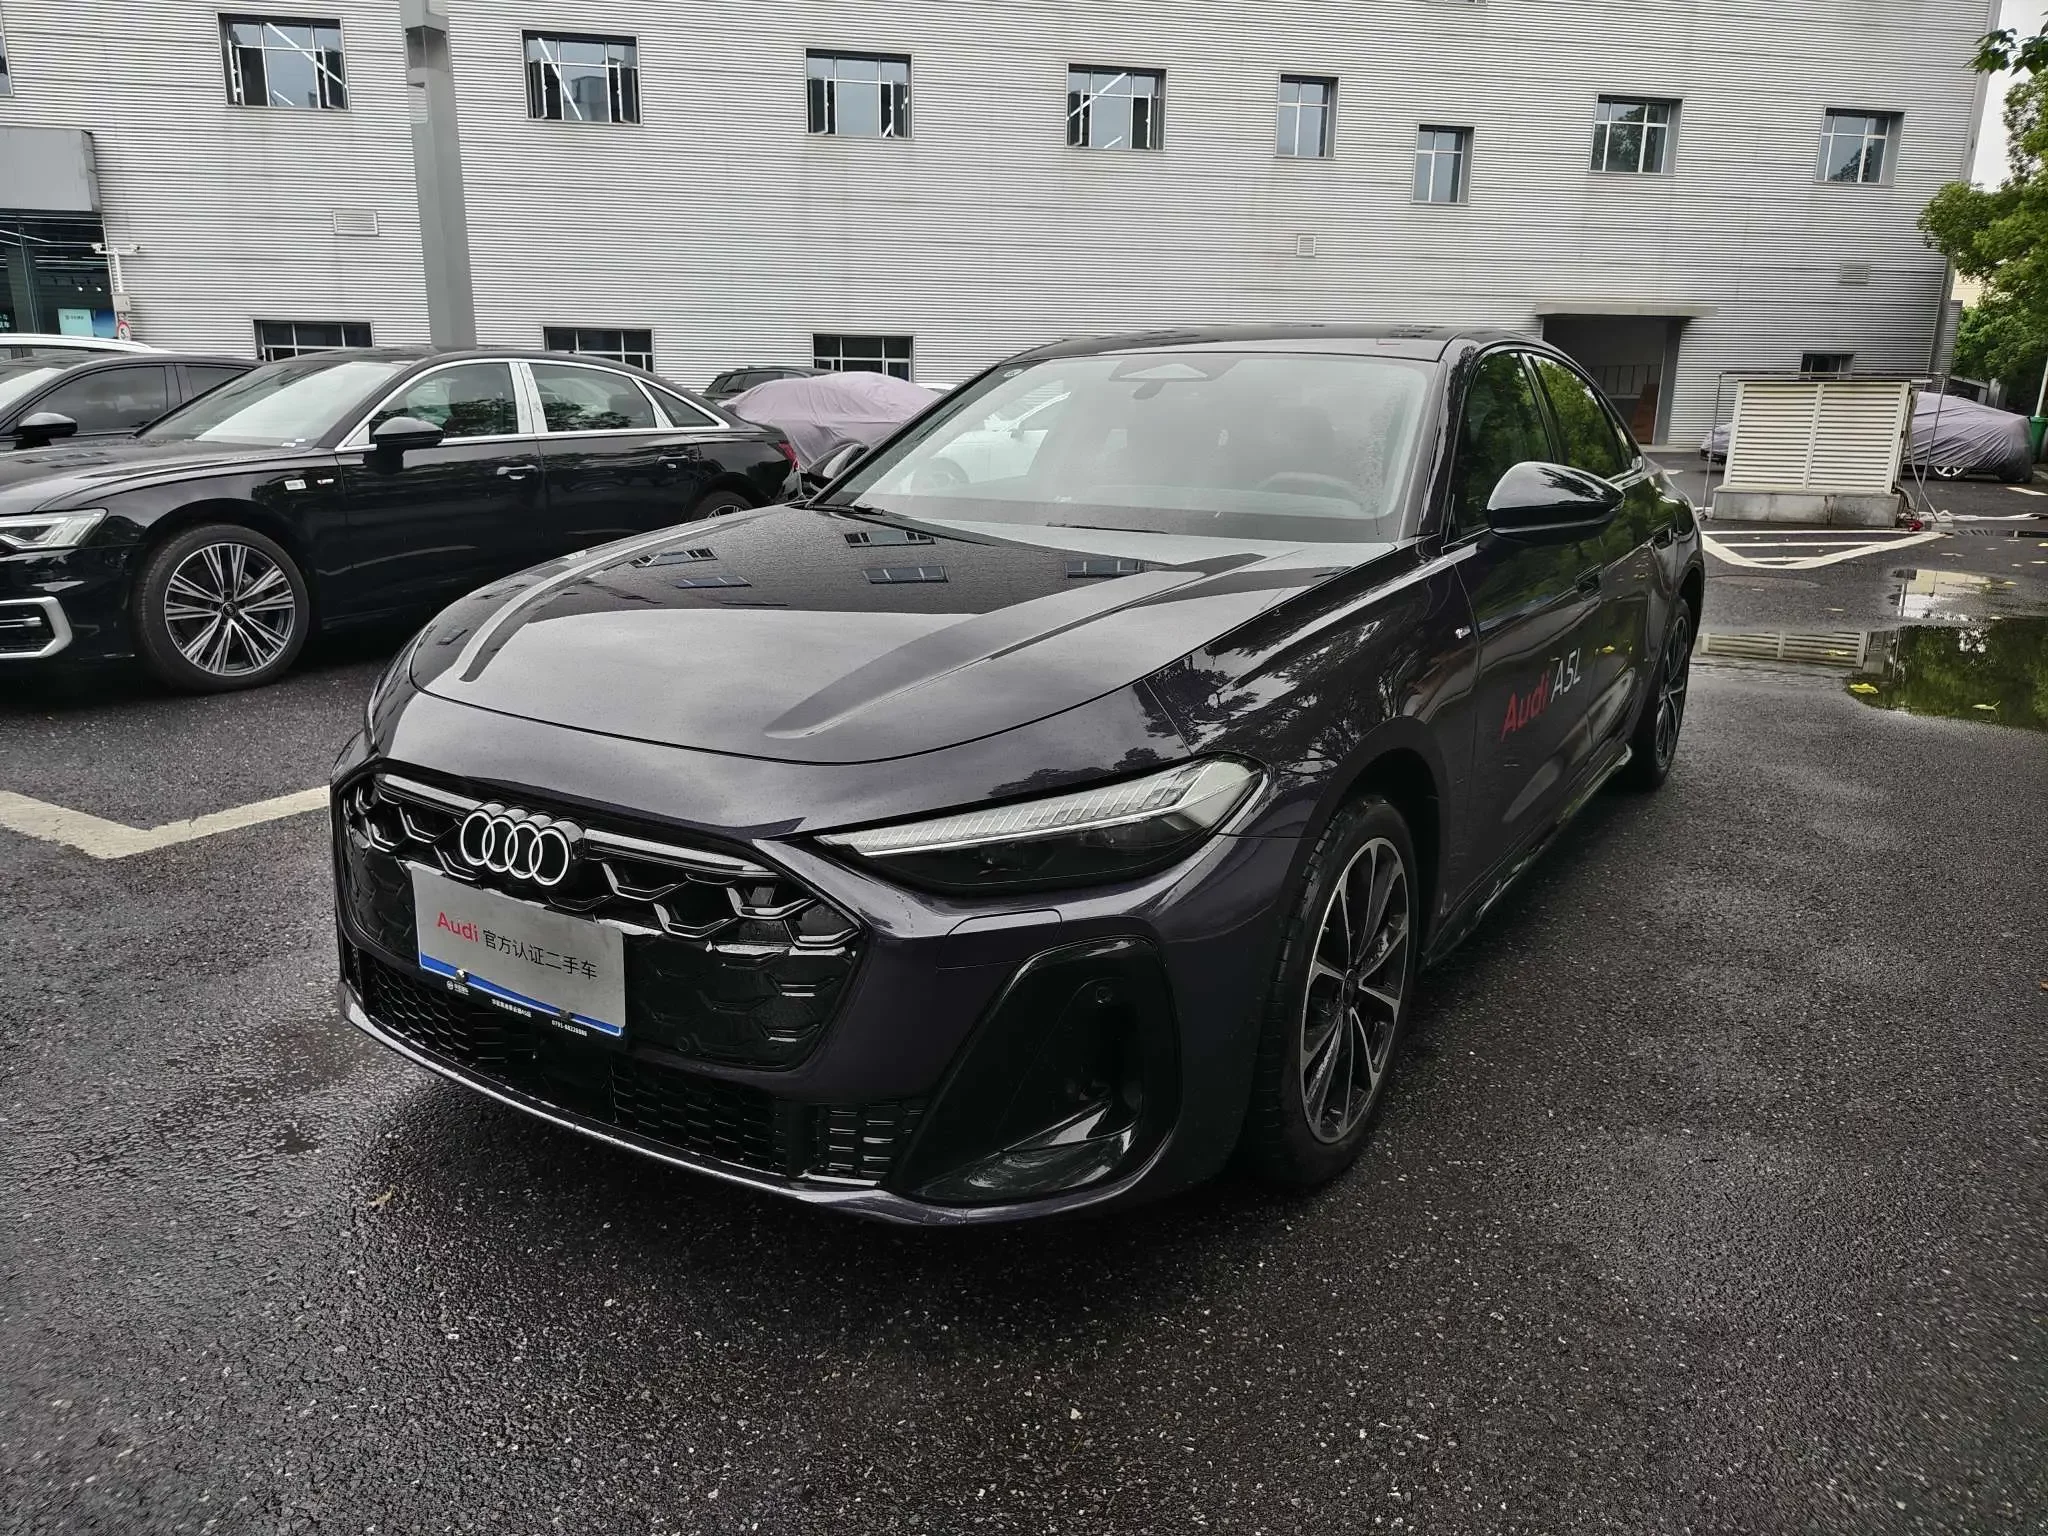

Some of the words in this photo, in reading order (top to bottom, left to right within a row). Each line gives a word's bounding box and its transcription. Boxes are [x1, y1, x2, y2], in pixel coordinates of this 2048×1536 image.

[1500, 669, 1550, 742] Audi
[1550, 648, 1581, 703] A5L
[437, 911, 479, 943] Audi
[483, 928, 599, 980] 官方认证二手车
